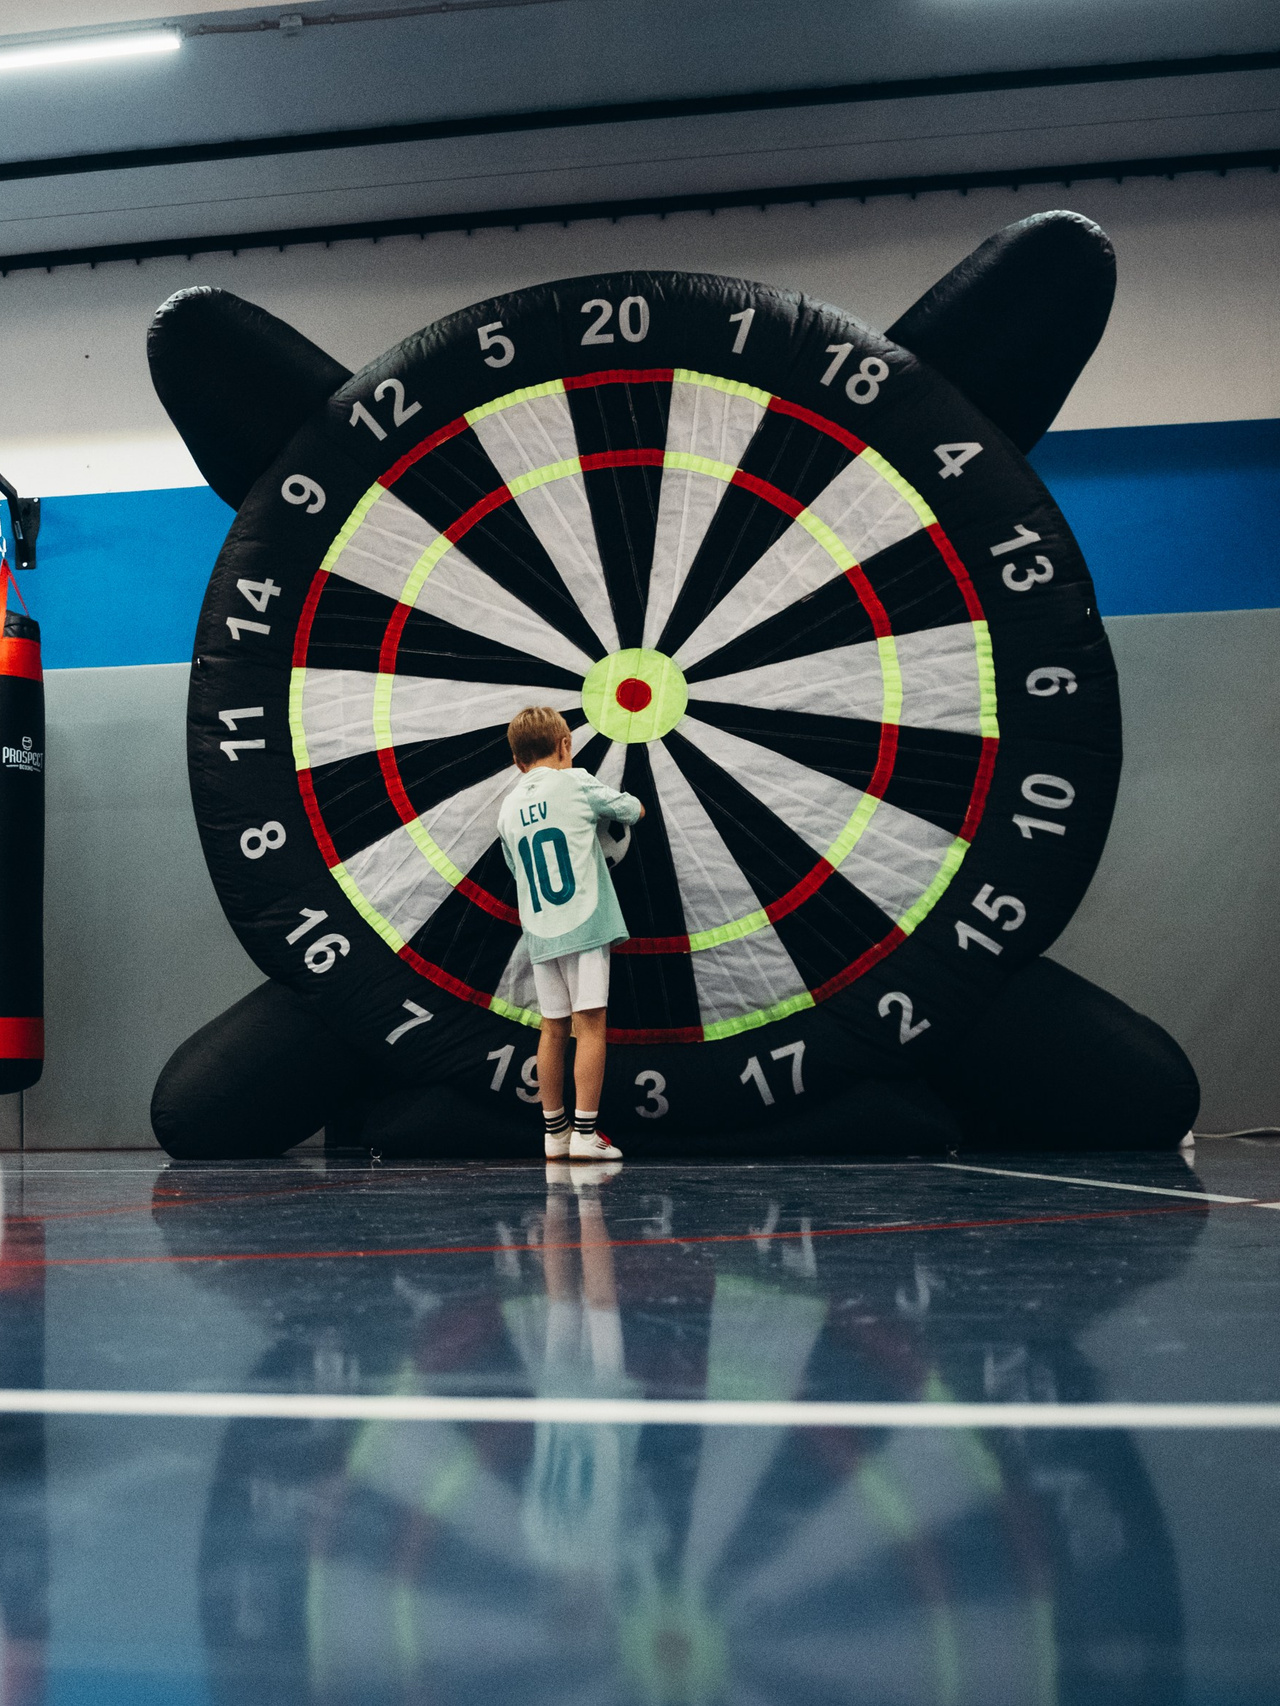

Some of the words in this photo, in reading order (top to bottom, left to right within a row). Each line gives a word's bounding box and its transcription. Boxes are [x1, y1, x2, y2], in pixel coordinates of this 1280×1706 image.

[477, 321, 515, 369] 5
[580, 296, 650, 346] 20
[729, 307, 756, 354] 1
[820, 341, 890, 405] 18
[349, 377, 423, 441] 12
[933, 441, 984, 479] 4
[280, 473, 327, 514] 9
[990, 524, 1054, 592] 13
[225, 578, 282, 641] 14
[1025, 666, 1078, 697] 6
[2, 746, 43, 769] PROSPECT
[218, 706, 266, 762] 11
[520, 801, 547, 827] LEV
[1011, 773, 1076, 839] 10
[239, 820, 287, 860] 8
[518, 827, 576, 913] 10
[285, 907, 352, 974] 16
[954, 883, 1027, 956] 15
[385, 998, 434, 1045] 7
[877, 991, 931, 1044] 2
[634, 1069, 669, 1119] 3
[739, 1039, 806, 1105] 17
